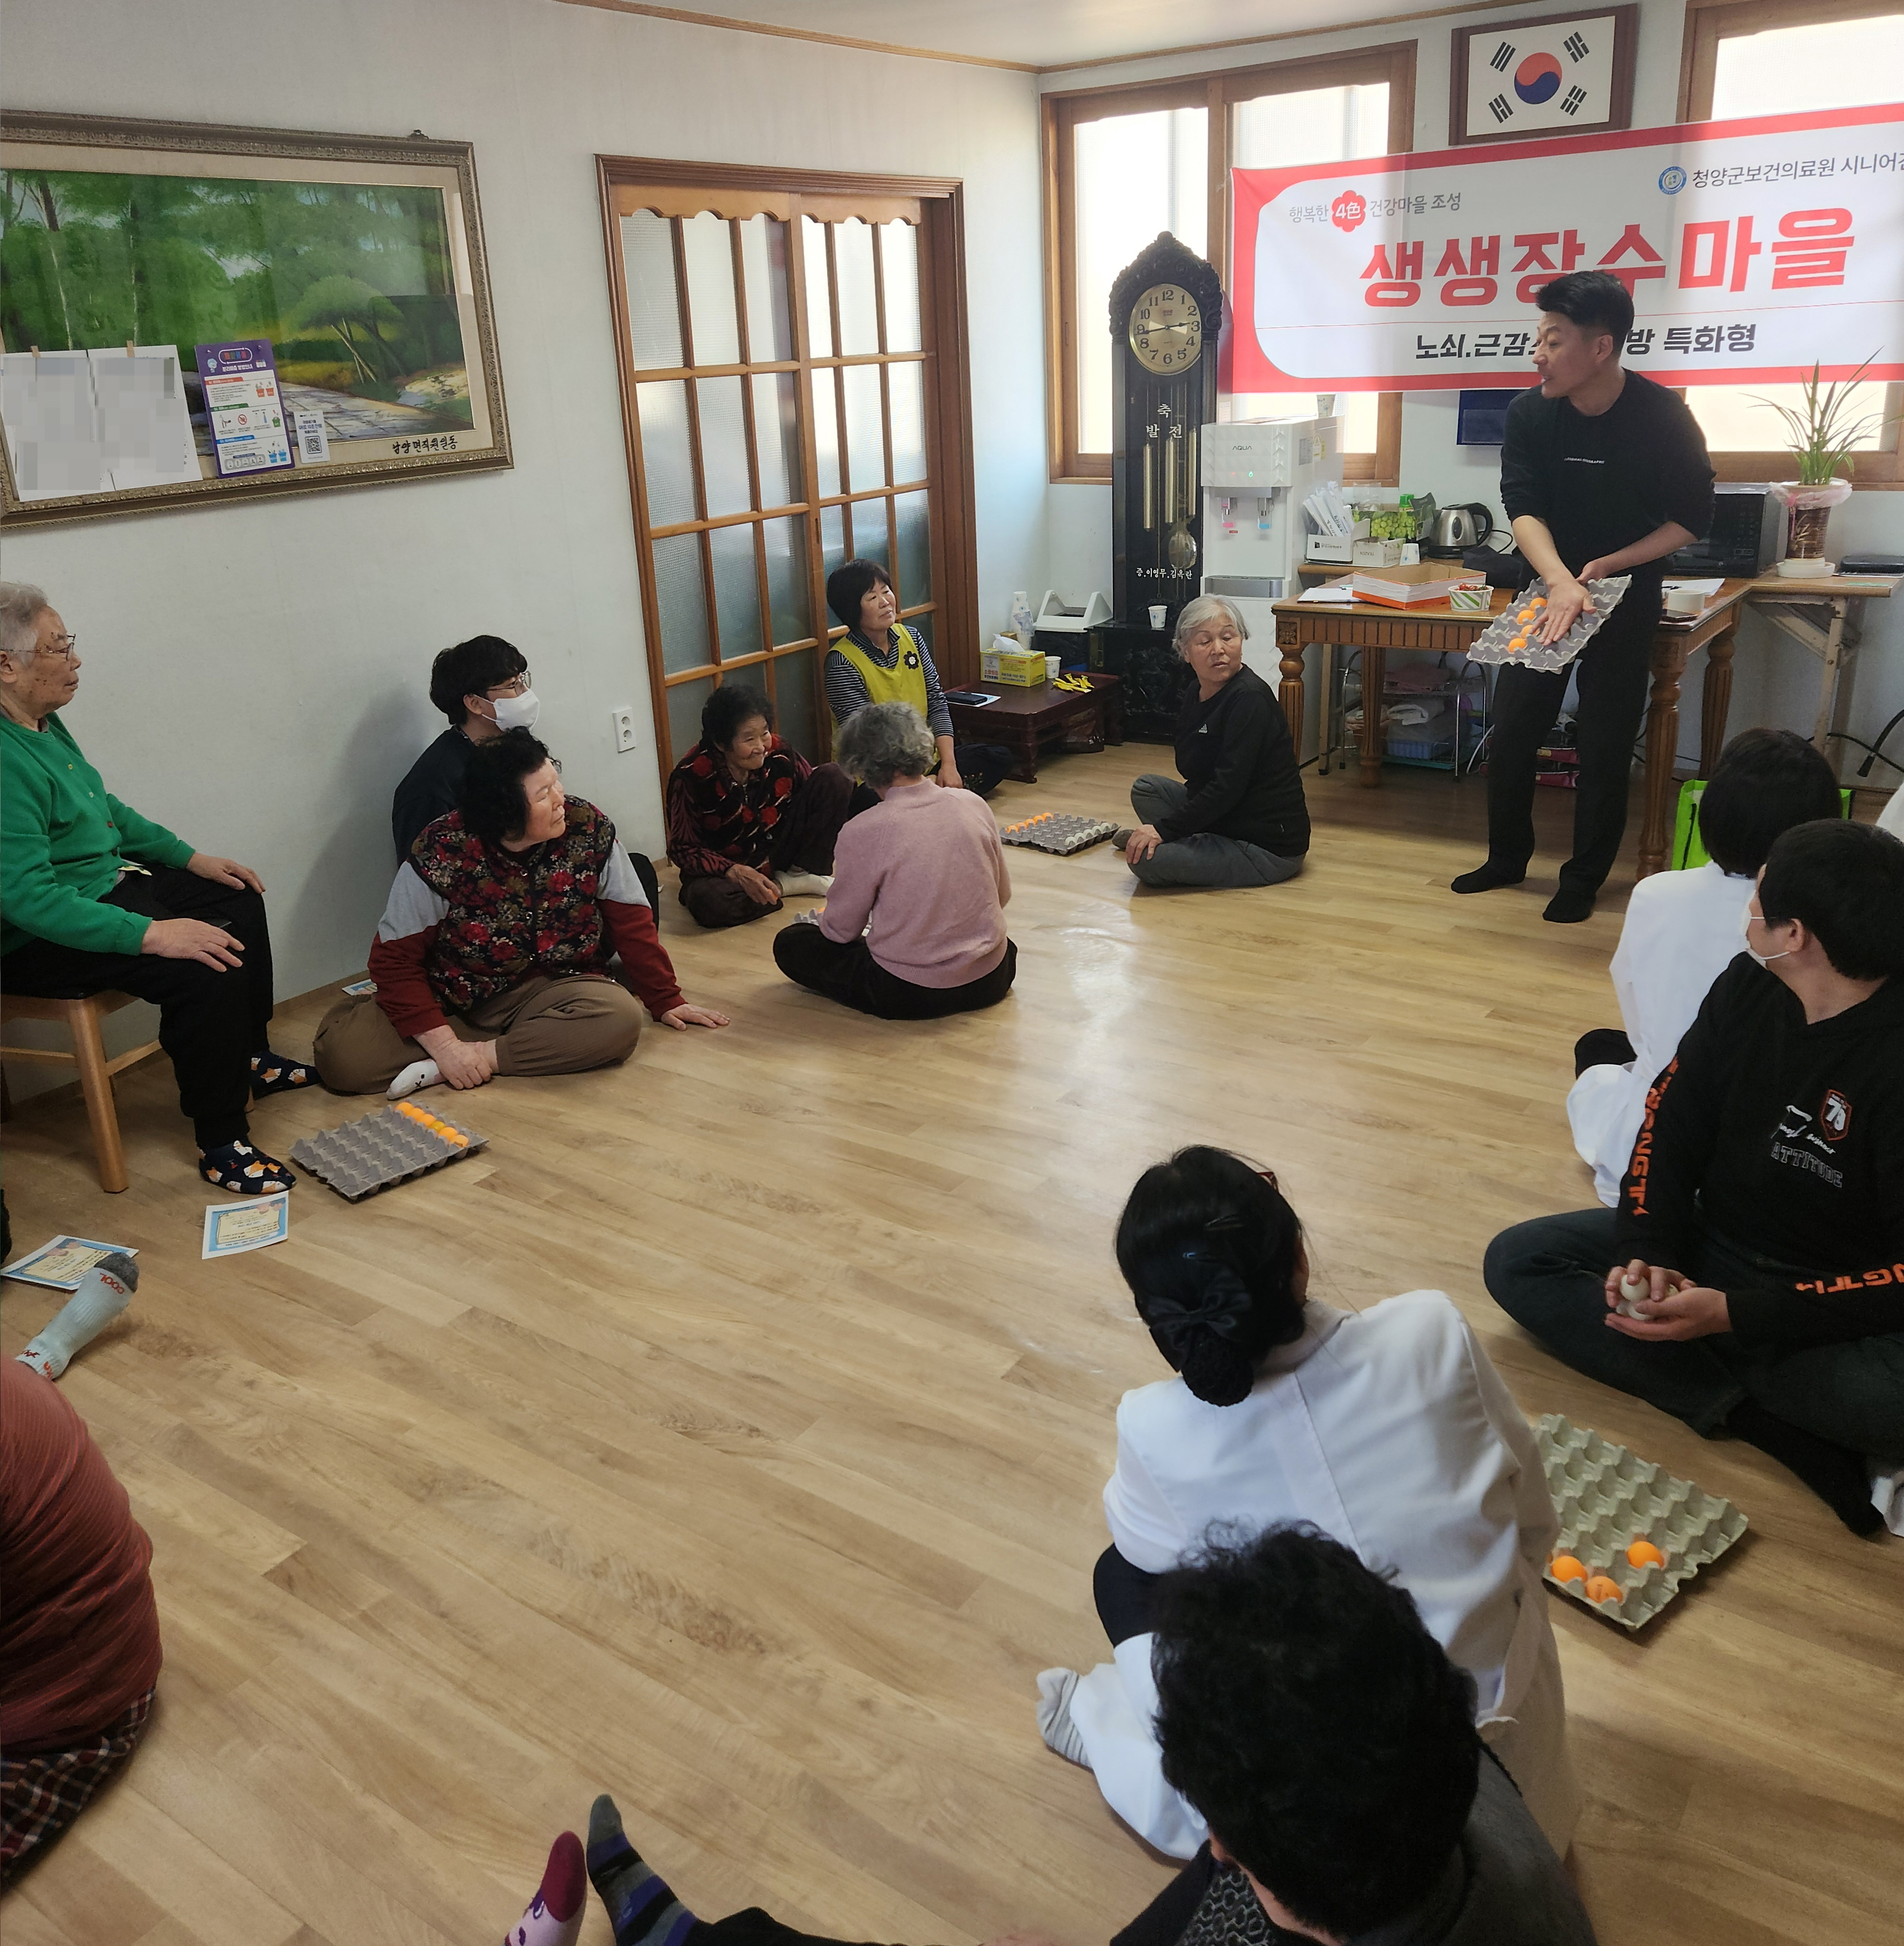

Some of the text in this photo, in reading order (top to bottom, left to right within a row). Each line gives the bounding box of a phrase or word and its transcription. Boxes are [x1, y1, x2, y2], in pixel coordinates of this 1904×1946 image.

[1692, 157, 1835, 188] 청양군보건의료원
[1289, 192, 1461, 223] 행복한 4色 건강마을 조성
[1359, 207, 1855, 307] 생생장수마을
[1149, 296, 1159, 306] 11
[1162, 290, 1174, 301] 12
[1181, 294, 1185, 305] 1
[1140, 309, 1150, 319] 10
[1187, 305, 1197, 316] 2
[1191, 321, 1200, 332] 3
[1139, 338, 1149, 349] 8
[1186, 336, 1196, 347] 4
[1626, 328, 1656, 355] 방
[1663, 324, 1756, 354] 특화형
[1149, 349, 1159, 360] 7
[1163, 353, 1172, 364] 6
[1177, 348, 1187, 360] 5
[1157, 403, 1172, 418] 축
[1146, 424, 1182, 439] 발 전
[1771, 1141, 1844, 1188] ATTITUDE
[100, 1272, 125, 1295] COOL
